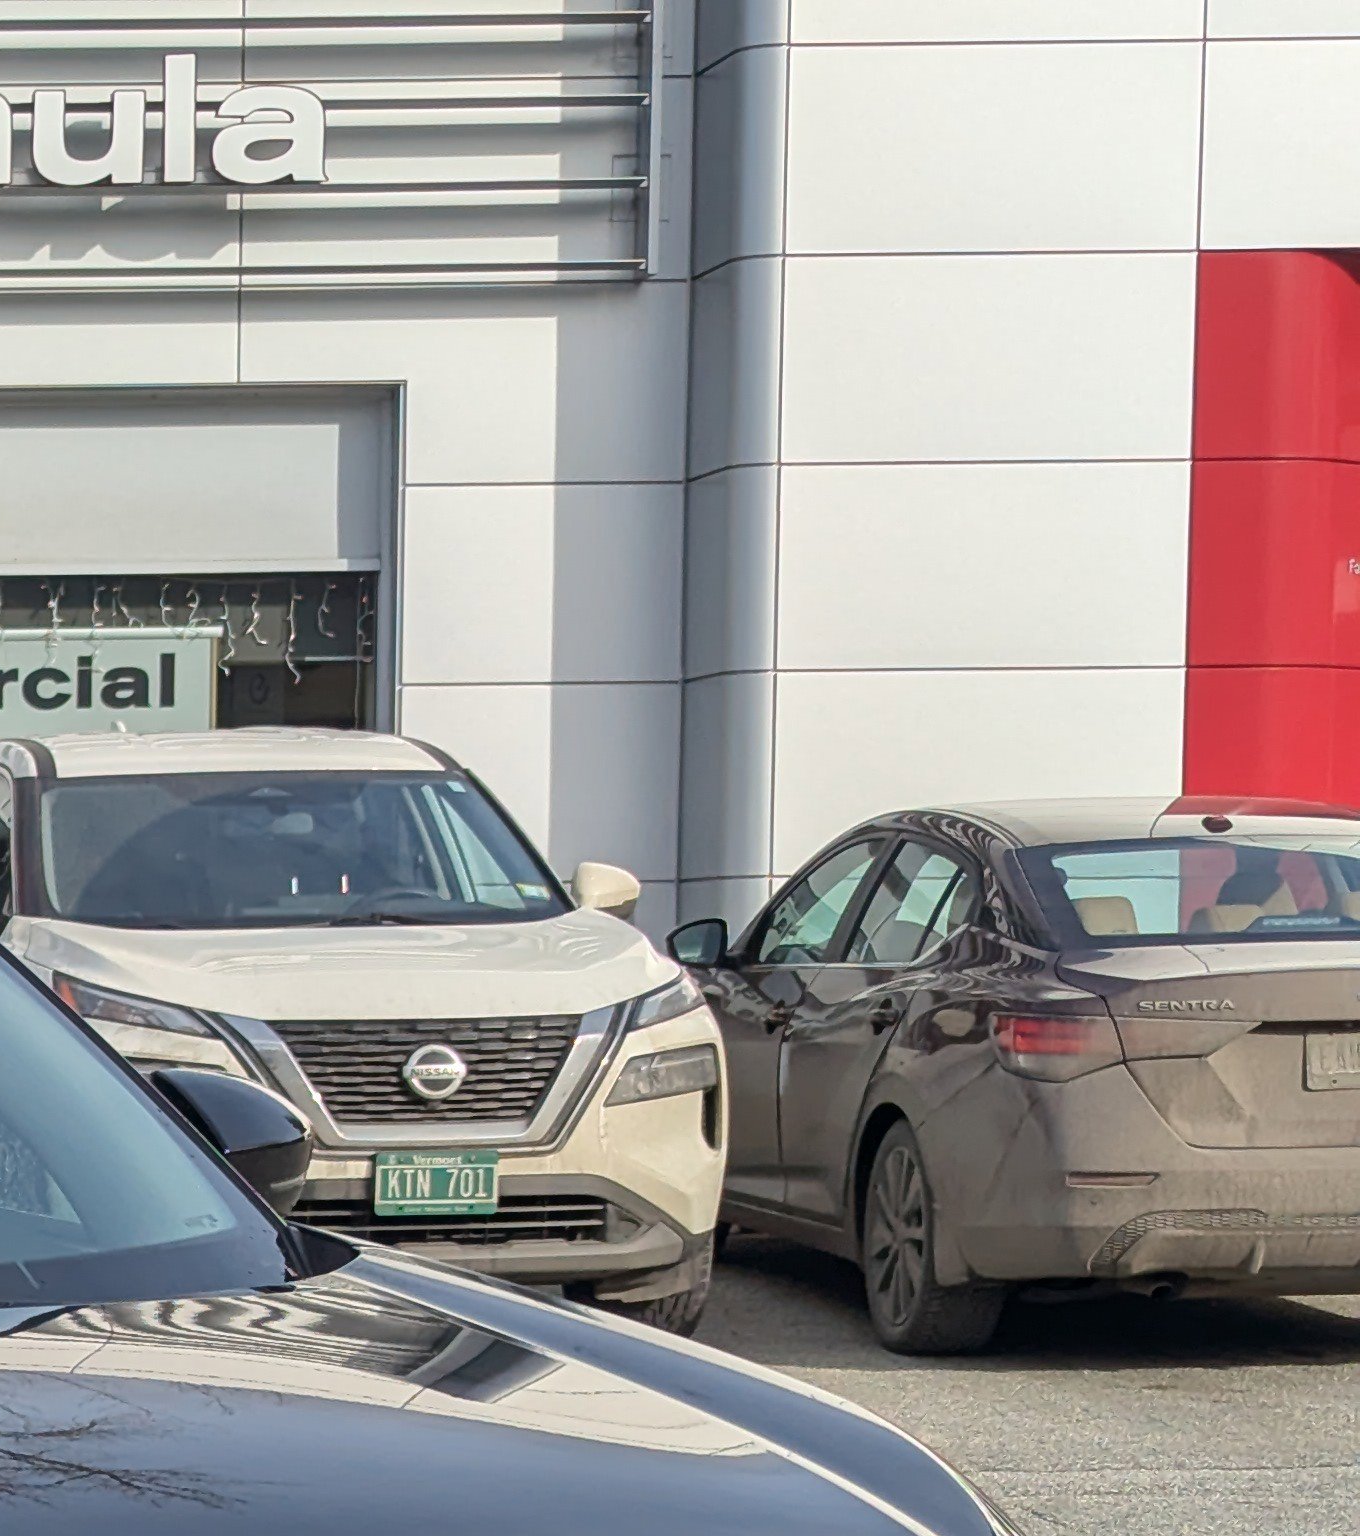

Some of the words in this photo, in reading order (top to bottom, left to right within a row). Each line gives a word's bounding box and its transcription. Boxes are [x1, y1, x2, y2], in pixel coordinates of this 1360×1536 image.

[1138, 999, 1236, 1012] SENTRA
[413, 1155, 462, 1165] Vermont
[387, 1168, 431, 1199] KTN
[446, 1168, 487, 1199] 701
